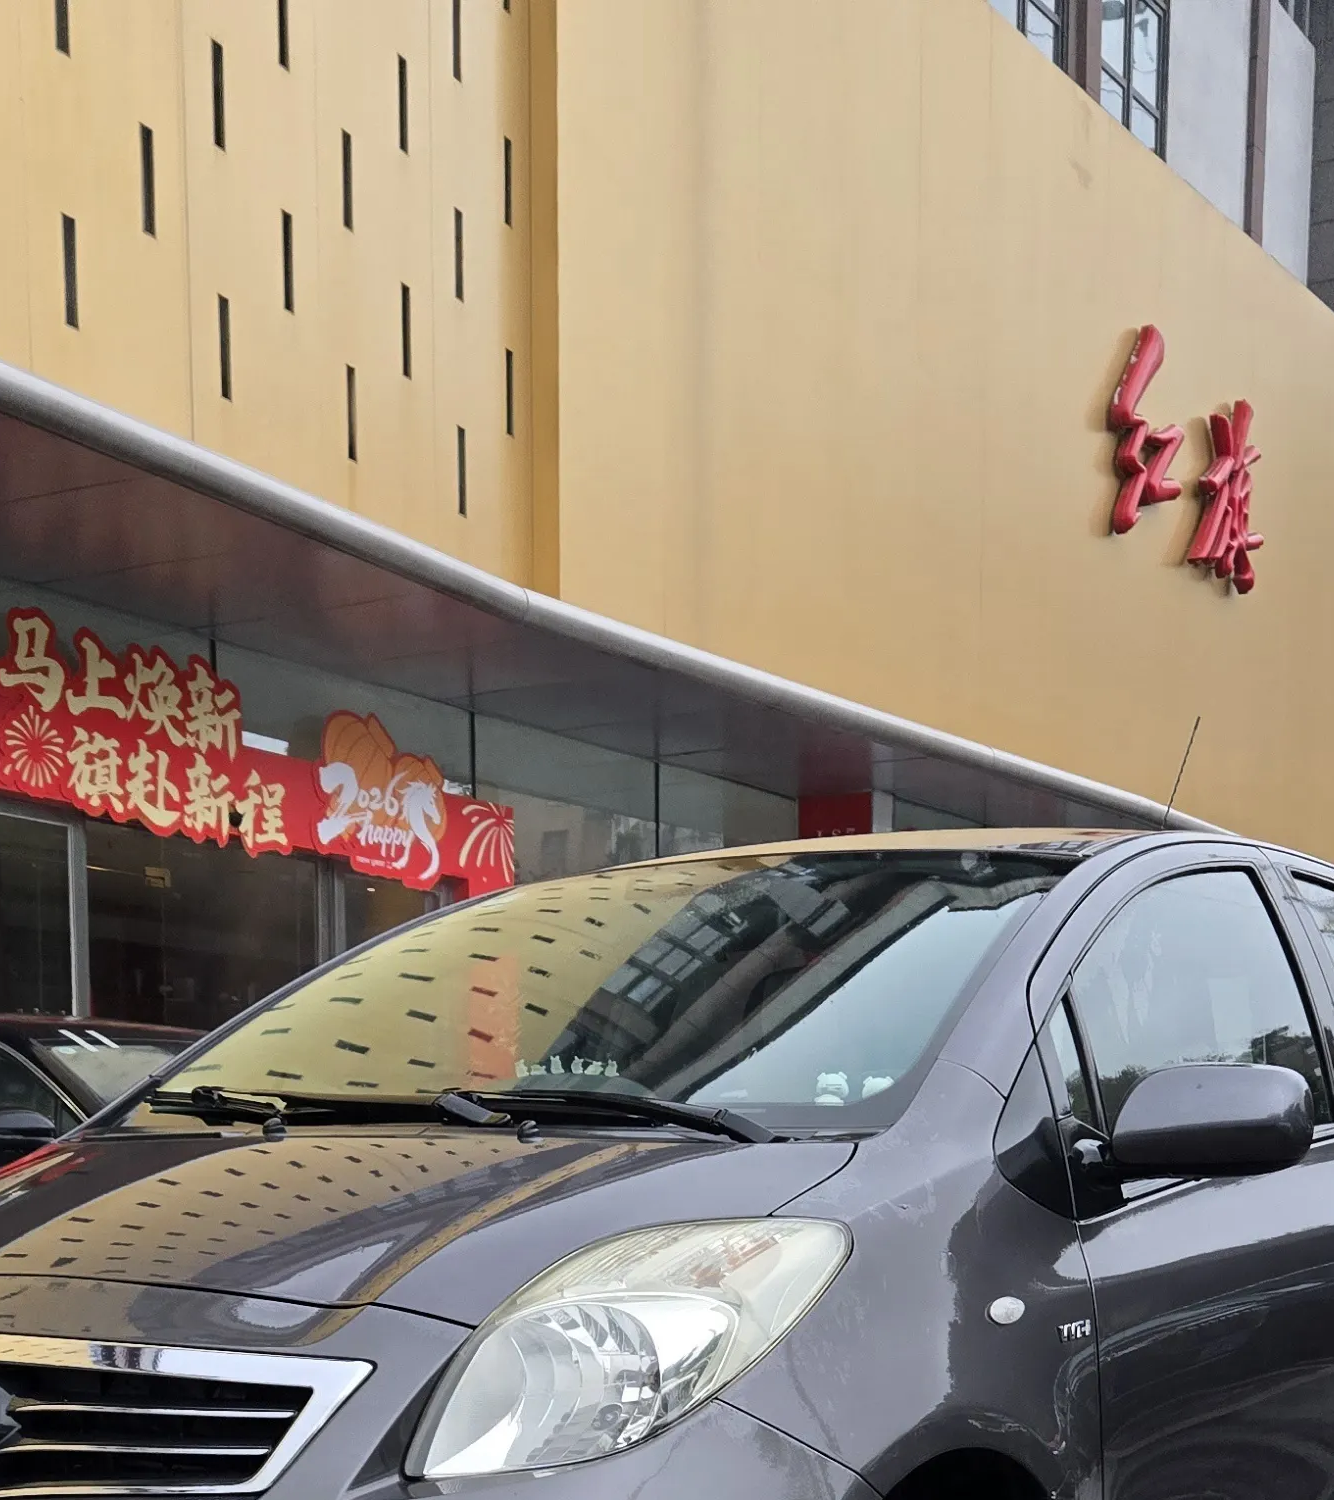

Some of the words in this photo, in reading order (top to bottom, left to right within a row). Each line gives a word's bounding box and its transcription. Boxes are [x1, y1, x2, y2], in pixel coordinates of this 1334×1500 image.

[1107, 324, 1264, 595] 红旗
[67, 725, 288, 849] 旗赴新程
[317, 762, 410, 845] 2026
[356, 810, 415, 869] happy
